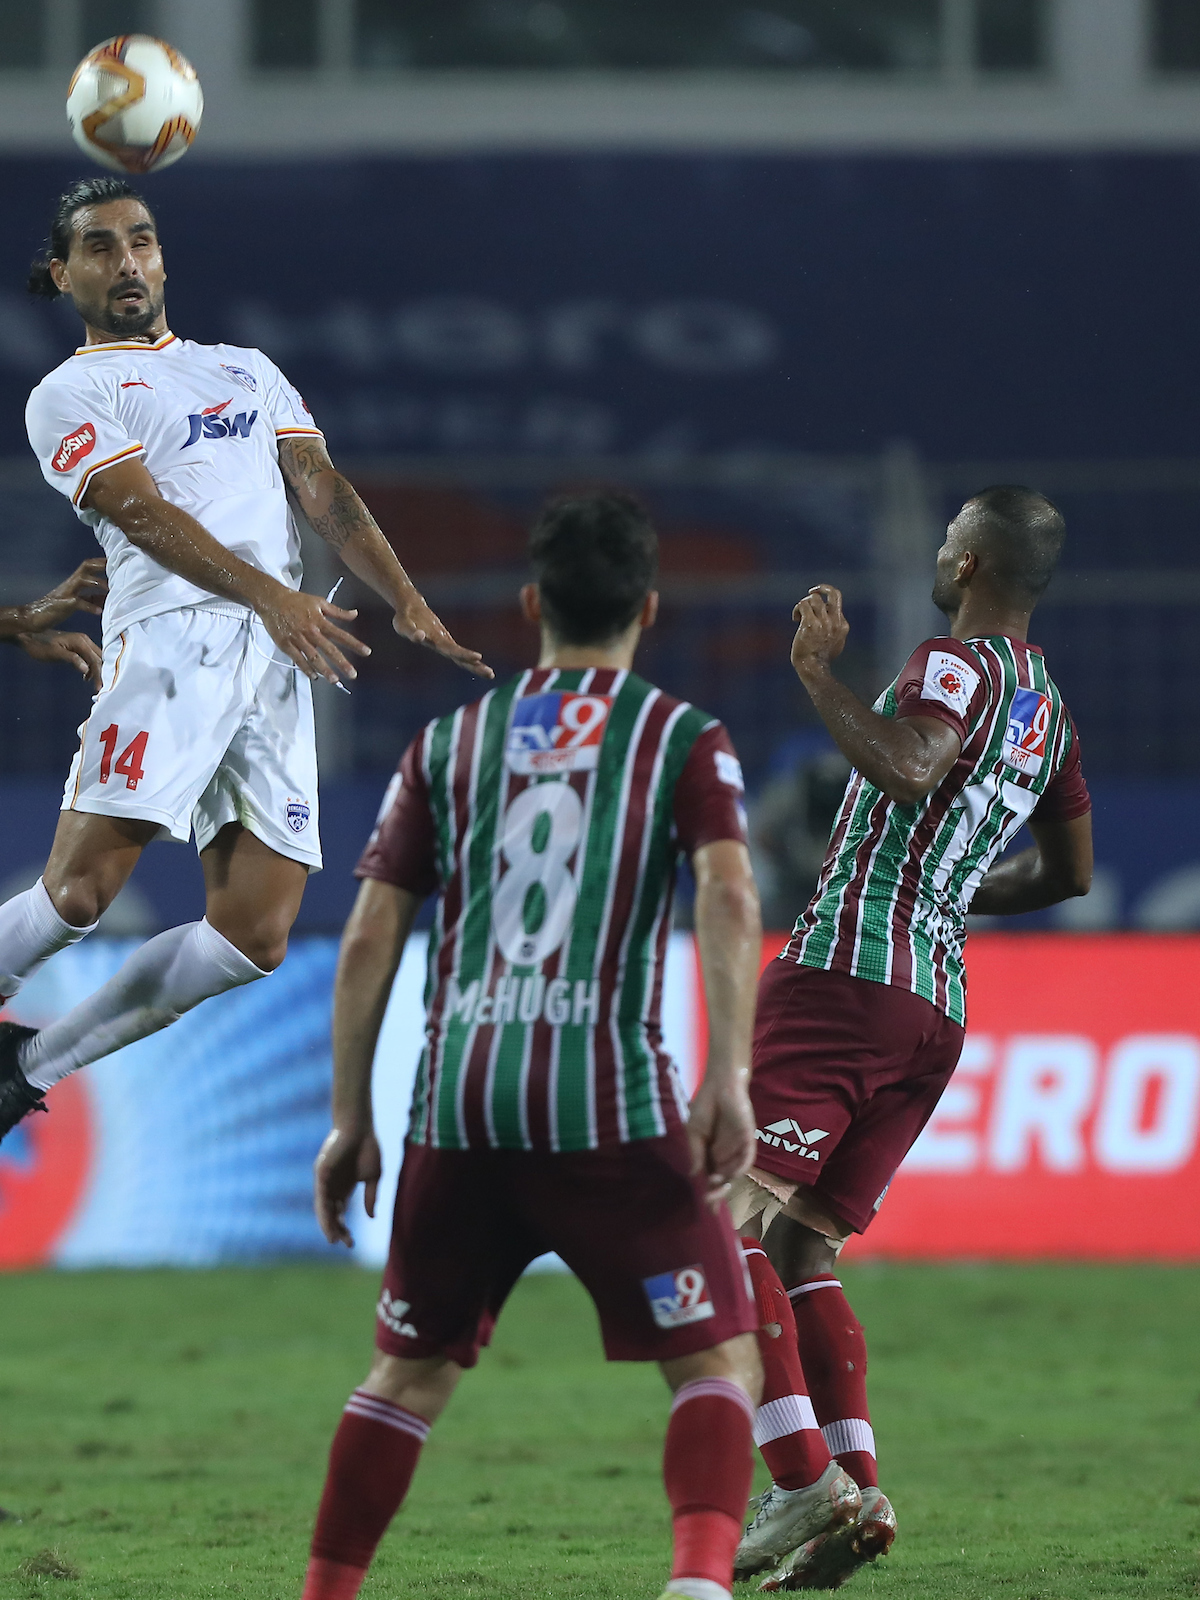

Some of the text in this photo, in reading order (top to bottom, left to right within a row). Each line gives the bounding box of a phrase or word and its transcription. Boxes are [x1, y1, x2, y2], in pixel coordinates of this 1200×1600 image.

[56, 429, 94, 470] NISSIN
[180, 410, 259, 450] JSW
[508, 696, 608, 750] TV9
[1005, 700, 1051, 748] TV9
[99, 723, 150, 791] 14
[492, 780, 583, 966] 8
[443, 976, 600, 1025] McHUGH
[754, 1128, 819, 1161] NIVIA
